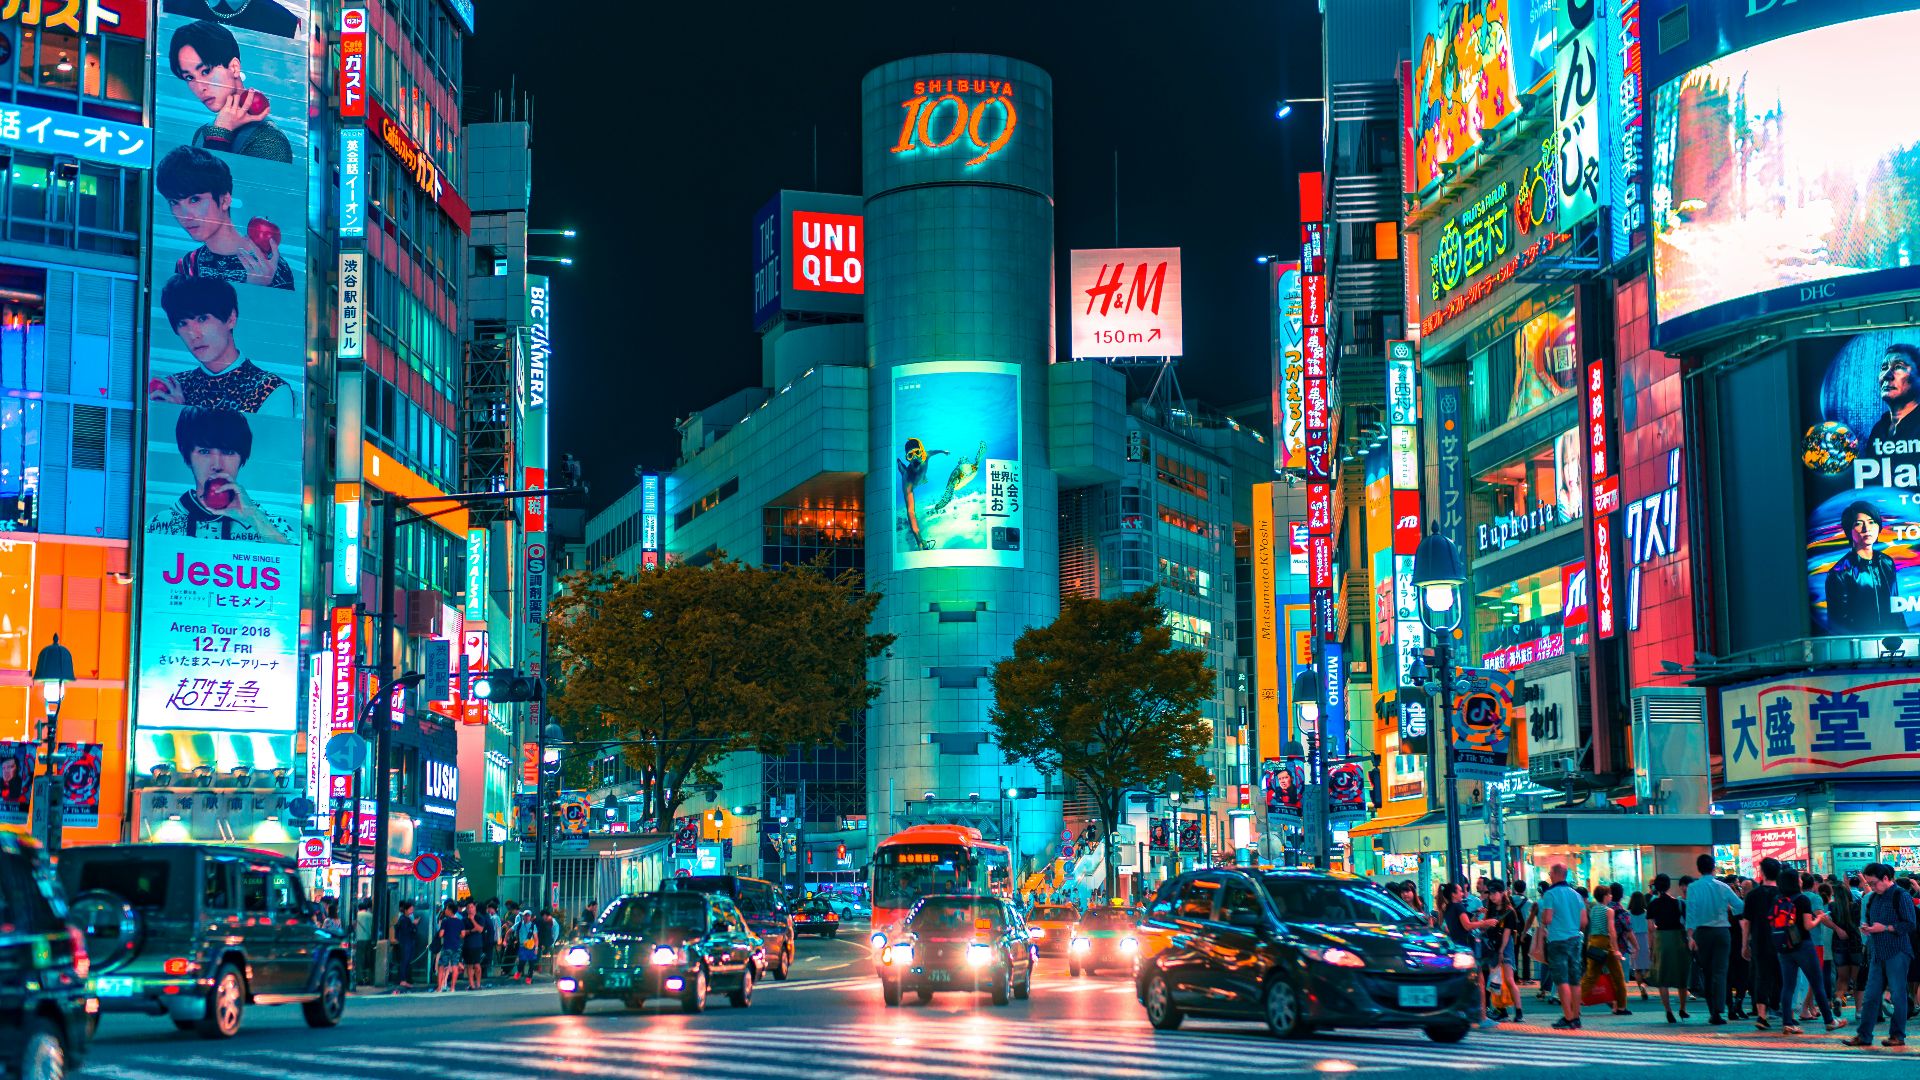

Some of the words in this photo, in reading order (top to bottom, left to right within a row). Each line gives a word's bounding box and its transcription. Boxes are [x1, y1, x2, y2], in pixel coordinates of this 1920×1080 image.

[346, 54, 362, 106] ガスト
[914, 79, 1013, 96] SHIBUYA
[889, 94, 1017, 166] 109
[346, 140, 358, 226] 英会話イーオン
[416, 151, 442, 203] ガスト
[760, 214, 774, 264] THE
[802, 221, 855, 252] UNI
[755, 255, 779, 314] PRIME
[802, 254, 862, 286] QLO
[344, 259, 358, 349] 渋谷駅前ビル
[531, 286, 545, 319] BIC
[1085, 261, 1167, 317] H&M
[1801, 283, 1835, 301] DHC
[1094, 330, 1143, 344] 150m
[531, 323, 552, 407] CAMERA
[990, 470, 1019, 483] 世界に
[1853, 457, 1920, 489] Pla
[1442, 435, 1464, 562] サマーフルー
[1397, 516, 1417, 529] JTB
[1478, 499, 1554, 550] Euphoria
[253, 555, 280, 563] SINGLE
[470, 534, 480, 564] レイク
[163, 553, 280, 590] Jesus
[170, 622, 207, 634] Arena
[212, 624, 238, 636] Tour
[241, 625, 271, 637] 2018
[193, 637, 231, 652] 12.7
[234, 644, 252, 653] FRI
[159, 655, 279, 670] さいたまスーパーアリーナ
[436, 644, 447, 697] 渋谷駅前
[1402, 640, 1411, 672] フルーツ
[1510, 647, 1532, 666] 海外旅行
[335, 642, 351, 721] サンドラッグ
[1328, 655, 1339, 706] MIZUHO
[1480, 756, 1494, 764] Tok
[426, 760, 457, 801] LUSH
[1740, 800, 1768, 808] TAISEIDO
